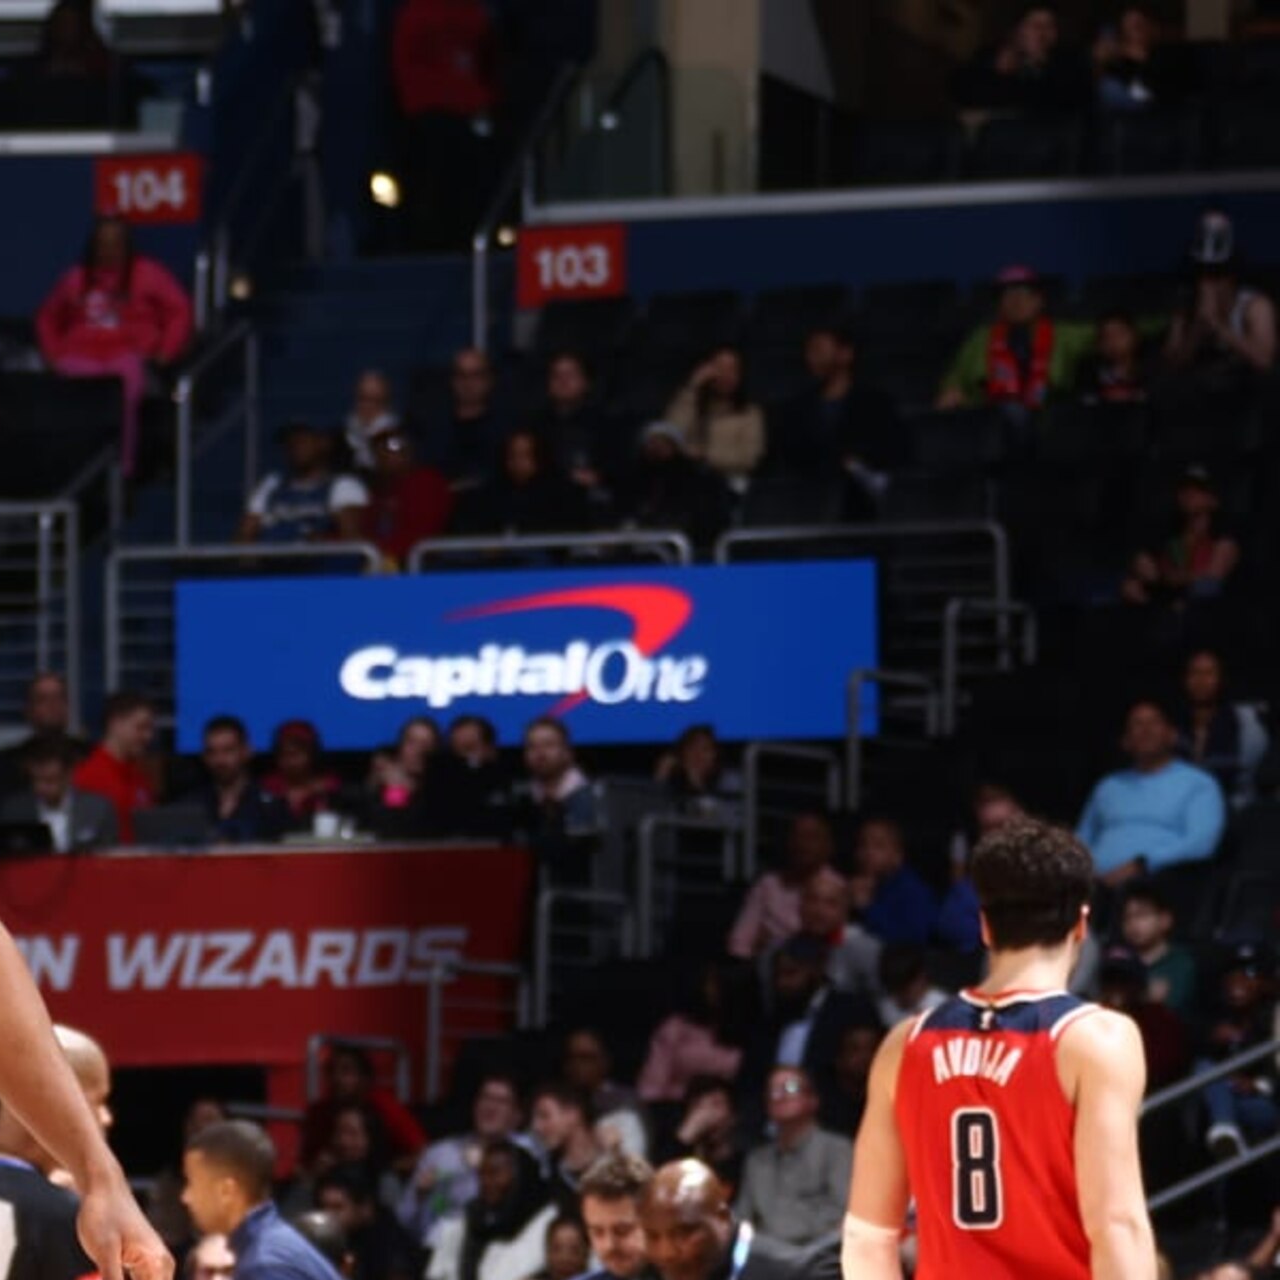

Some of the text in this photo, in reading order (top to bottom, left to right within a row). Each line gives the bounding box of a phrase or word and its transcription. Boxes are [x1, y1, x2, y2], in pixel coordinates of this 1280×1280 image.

[113, 168, 186, 213] 104
[534, 244, 609, 290] 103
[106, 928, 467, 990] WIZARDS
[951, 1106, 1003, 1230] 8
